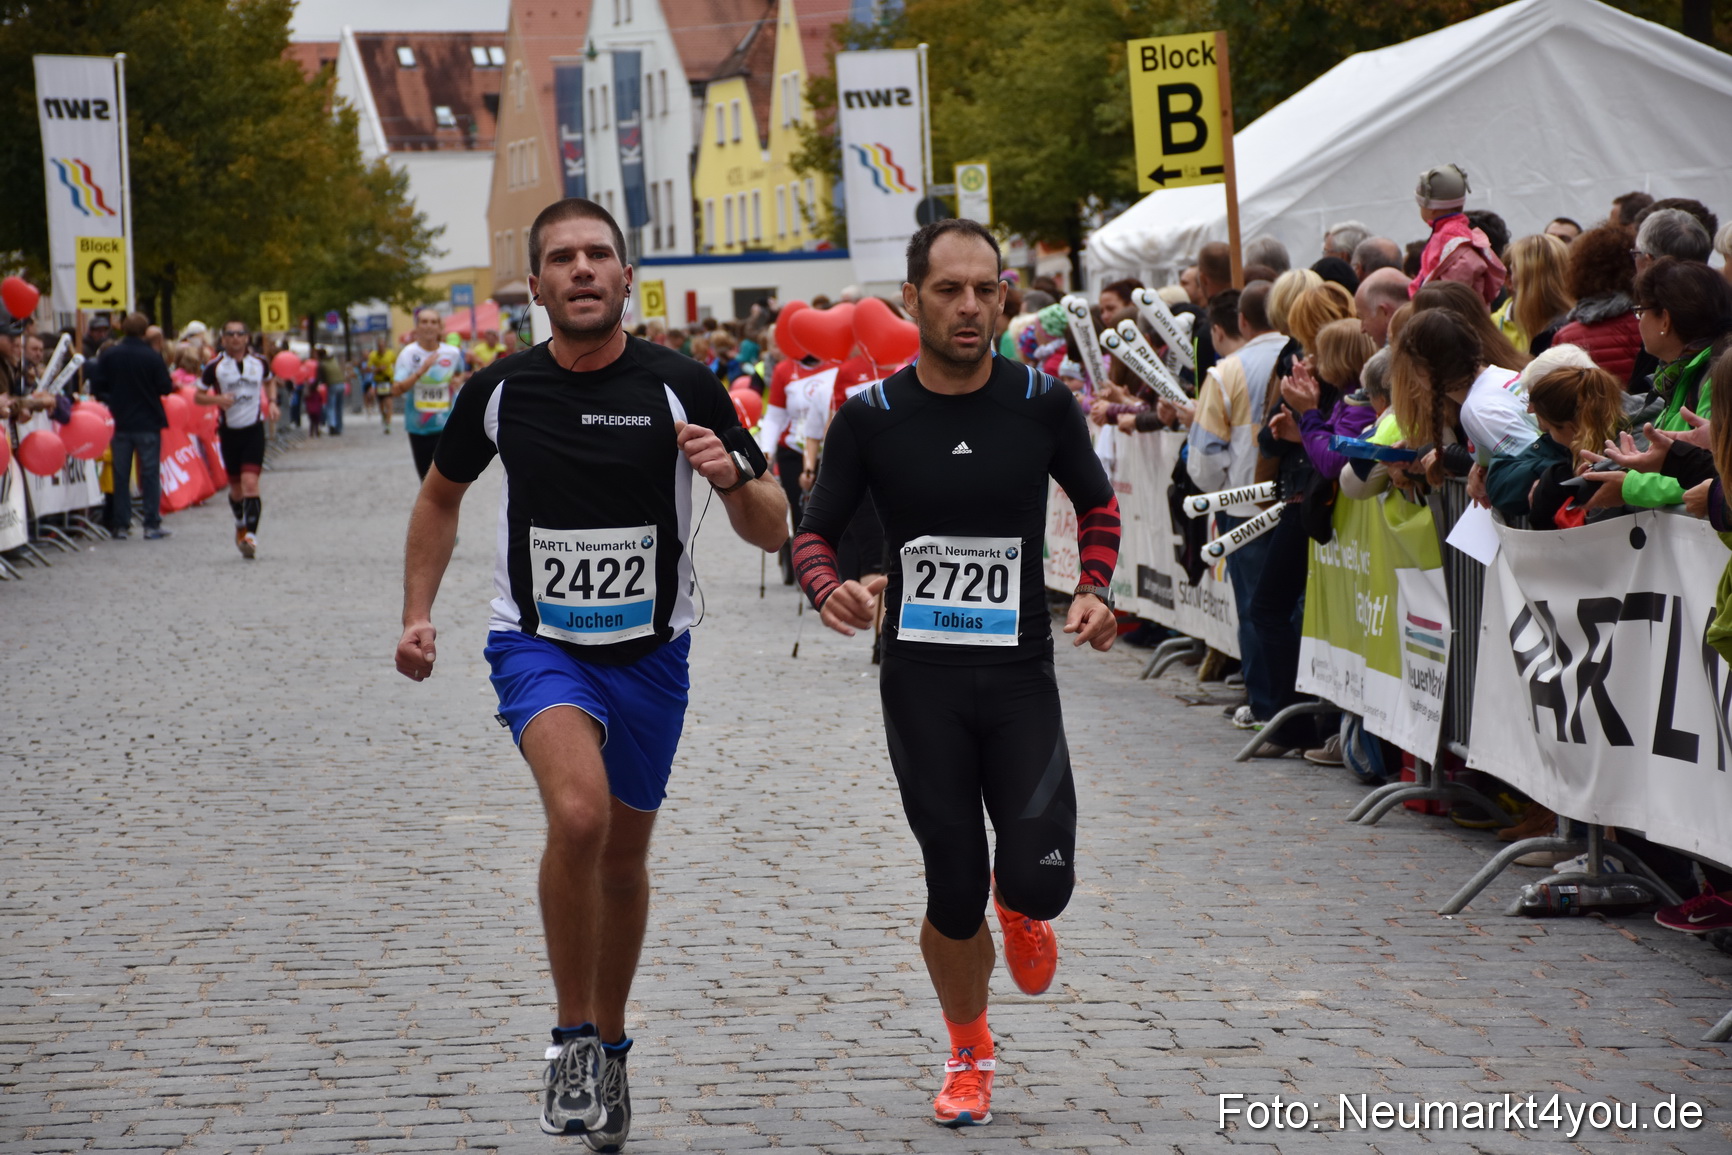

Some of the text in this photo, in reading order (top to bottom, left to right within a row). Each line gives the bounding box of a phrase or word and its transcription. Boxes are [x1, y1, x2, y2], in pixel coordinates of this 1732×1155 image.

[1141, 40, 1216, 71] Block
[1158, 82, 1208, 156] B
[80, 238, 119, 252] Block
[87, 258, 113, 293] C
[647, 291, 661, 309] D
[268, 304, 281, 323] D
[592, 414, 652, 426] PFLEIDERER
[1218, 487, 1256, 507] BMW
[1230, 519, 1266, 545] BMW
[533, 539, 637, 552] PARTL Neumarkt
[903, 546, 1001, 558] PARTL Neumarkt
[544, 555, 645, 600] 2422
[915, 559, 1009, 604] 2720
[566, 611, 624, 629] Jochen
[932, 610, 984, 630] Tobias
[1039, 859, 1066, 867] adidas
